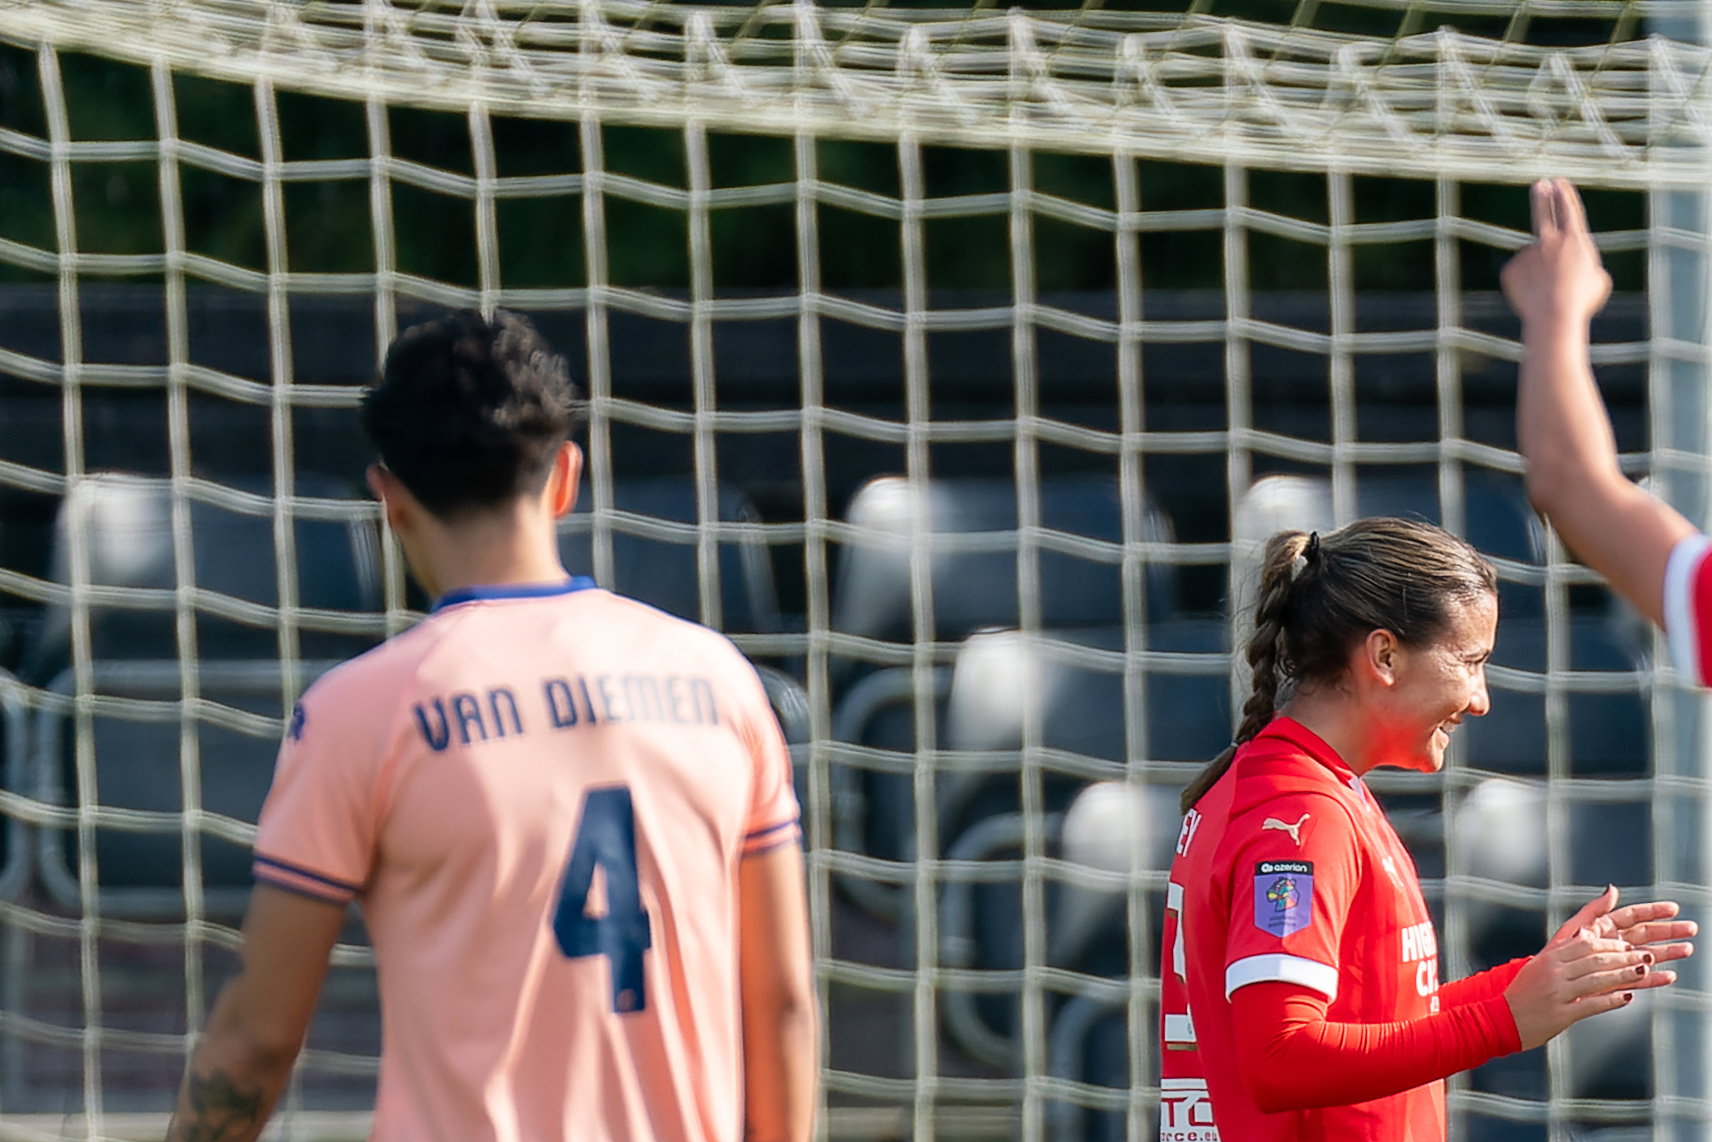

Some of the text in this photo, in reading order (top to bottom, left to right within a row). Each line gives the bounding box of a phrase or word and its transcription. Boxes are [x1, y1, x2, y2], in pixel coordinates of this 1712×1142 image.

[413, 672, 720, 752] VAN DIEMEN
[553, 787, 651, 1013] 4
[1274, 863, 1308, 873] azerion
